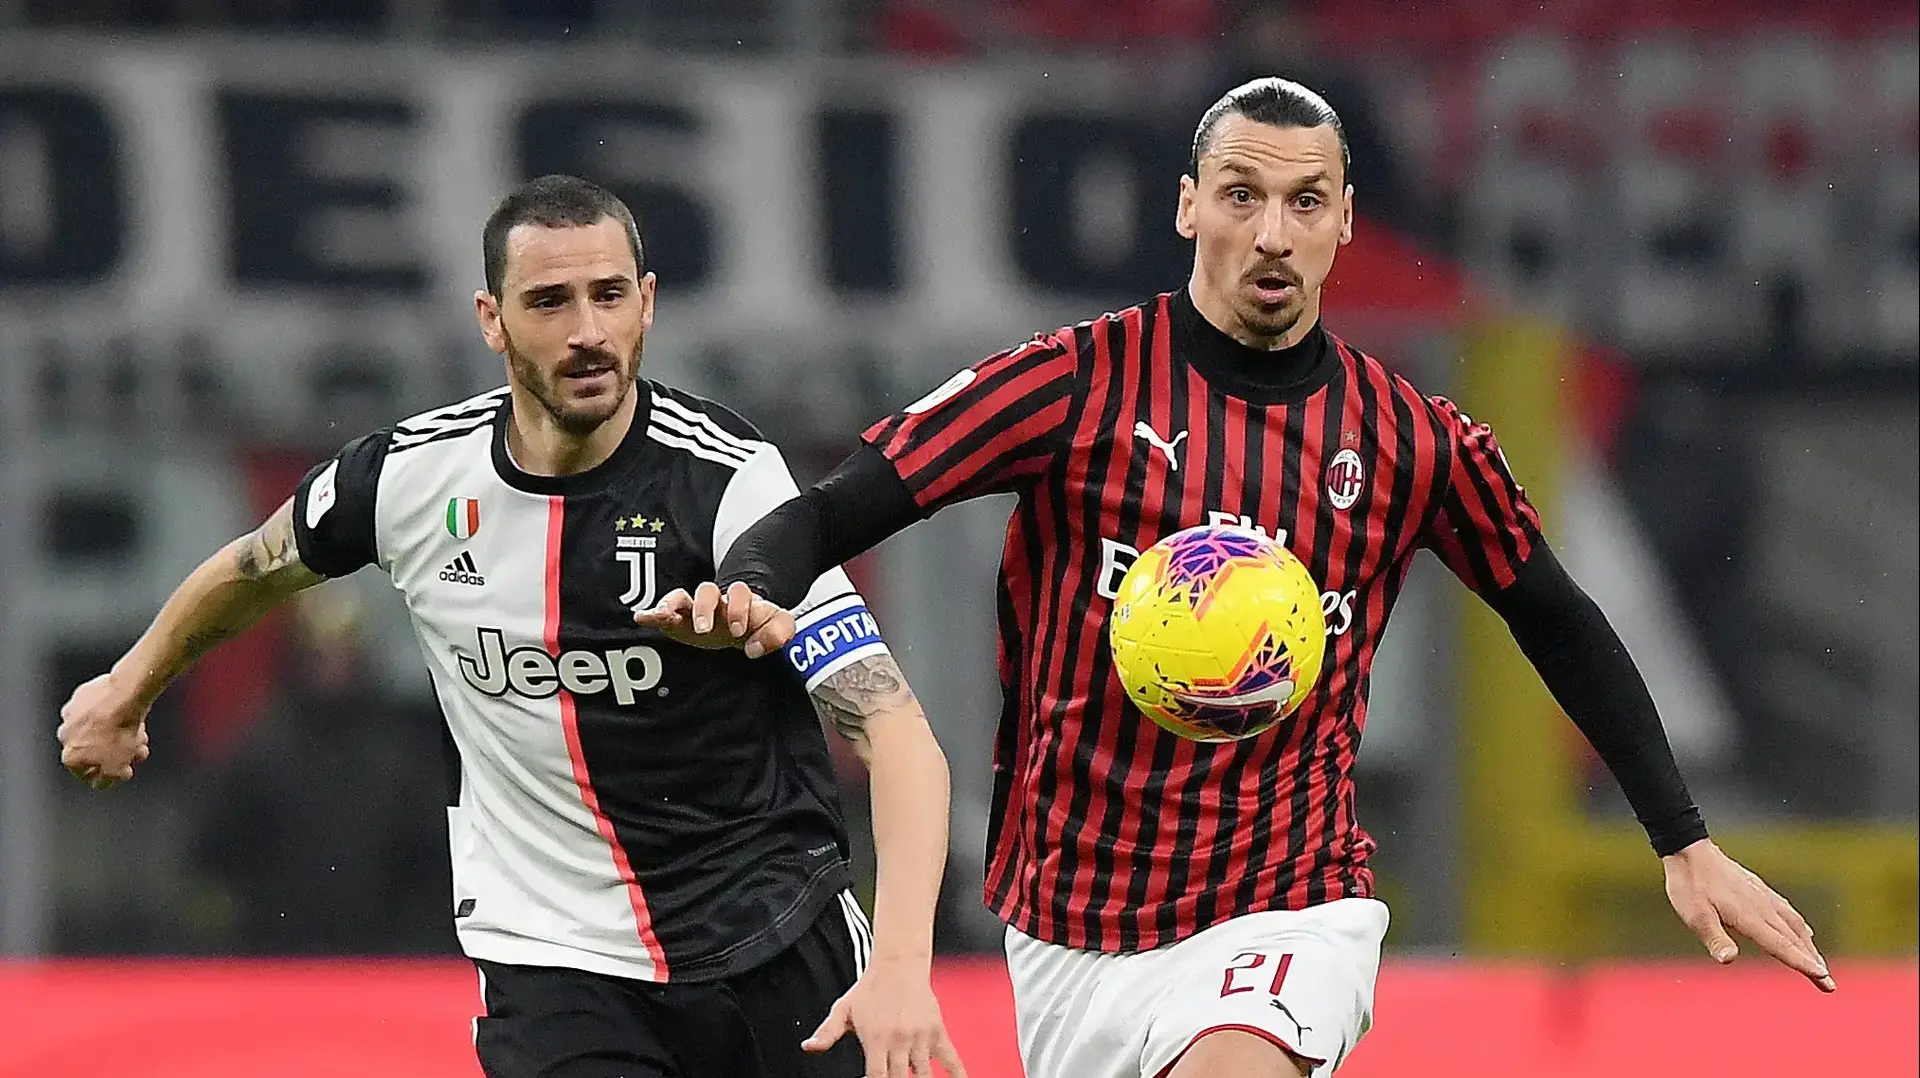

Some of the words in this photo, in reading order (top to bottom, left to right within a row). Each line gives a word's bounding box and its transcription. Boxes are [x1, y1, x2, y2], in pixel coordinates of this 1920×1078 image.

[439, 570, 486, 586] adidas
[457, 627, 663, 705] Jeep
[789, 611, 880, 672] CAPITA
[1220, 953, 1294, 998] 21
